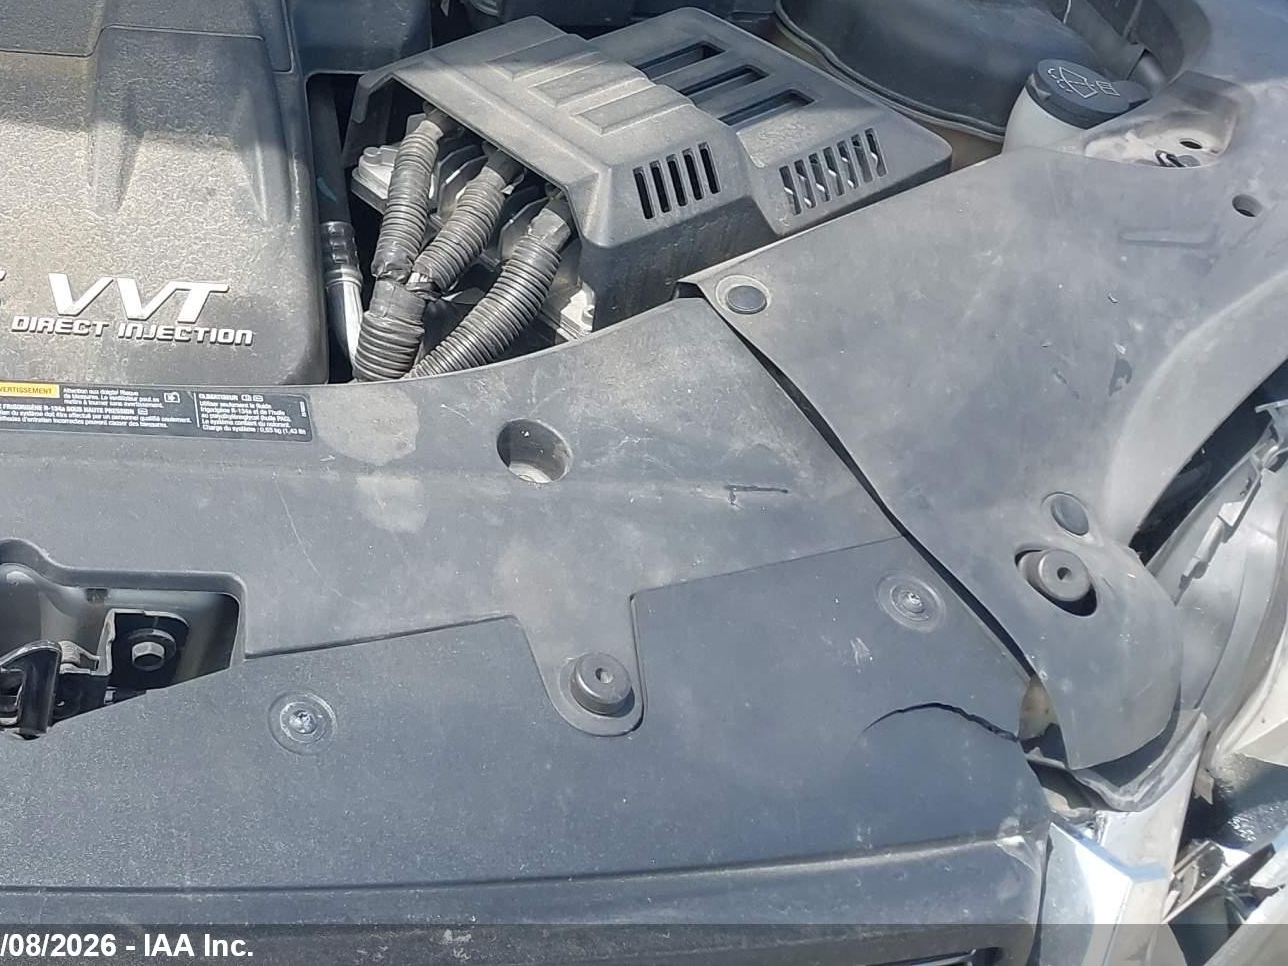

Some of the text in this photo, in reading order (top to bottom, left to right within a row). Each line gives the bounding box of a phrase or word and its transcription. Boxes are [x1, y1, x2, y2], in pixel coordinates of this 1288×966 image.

[48, 272, 229, 324] VVT
[12, 315, 254, 346] DIRECT INJECTION
